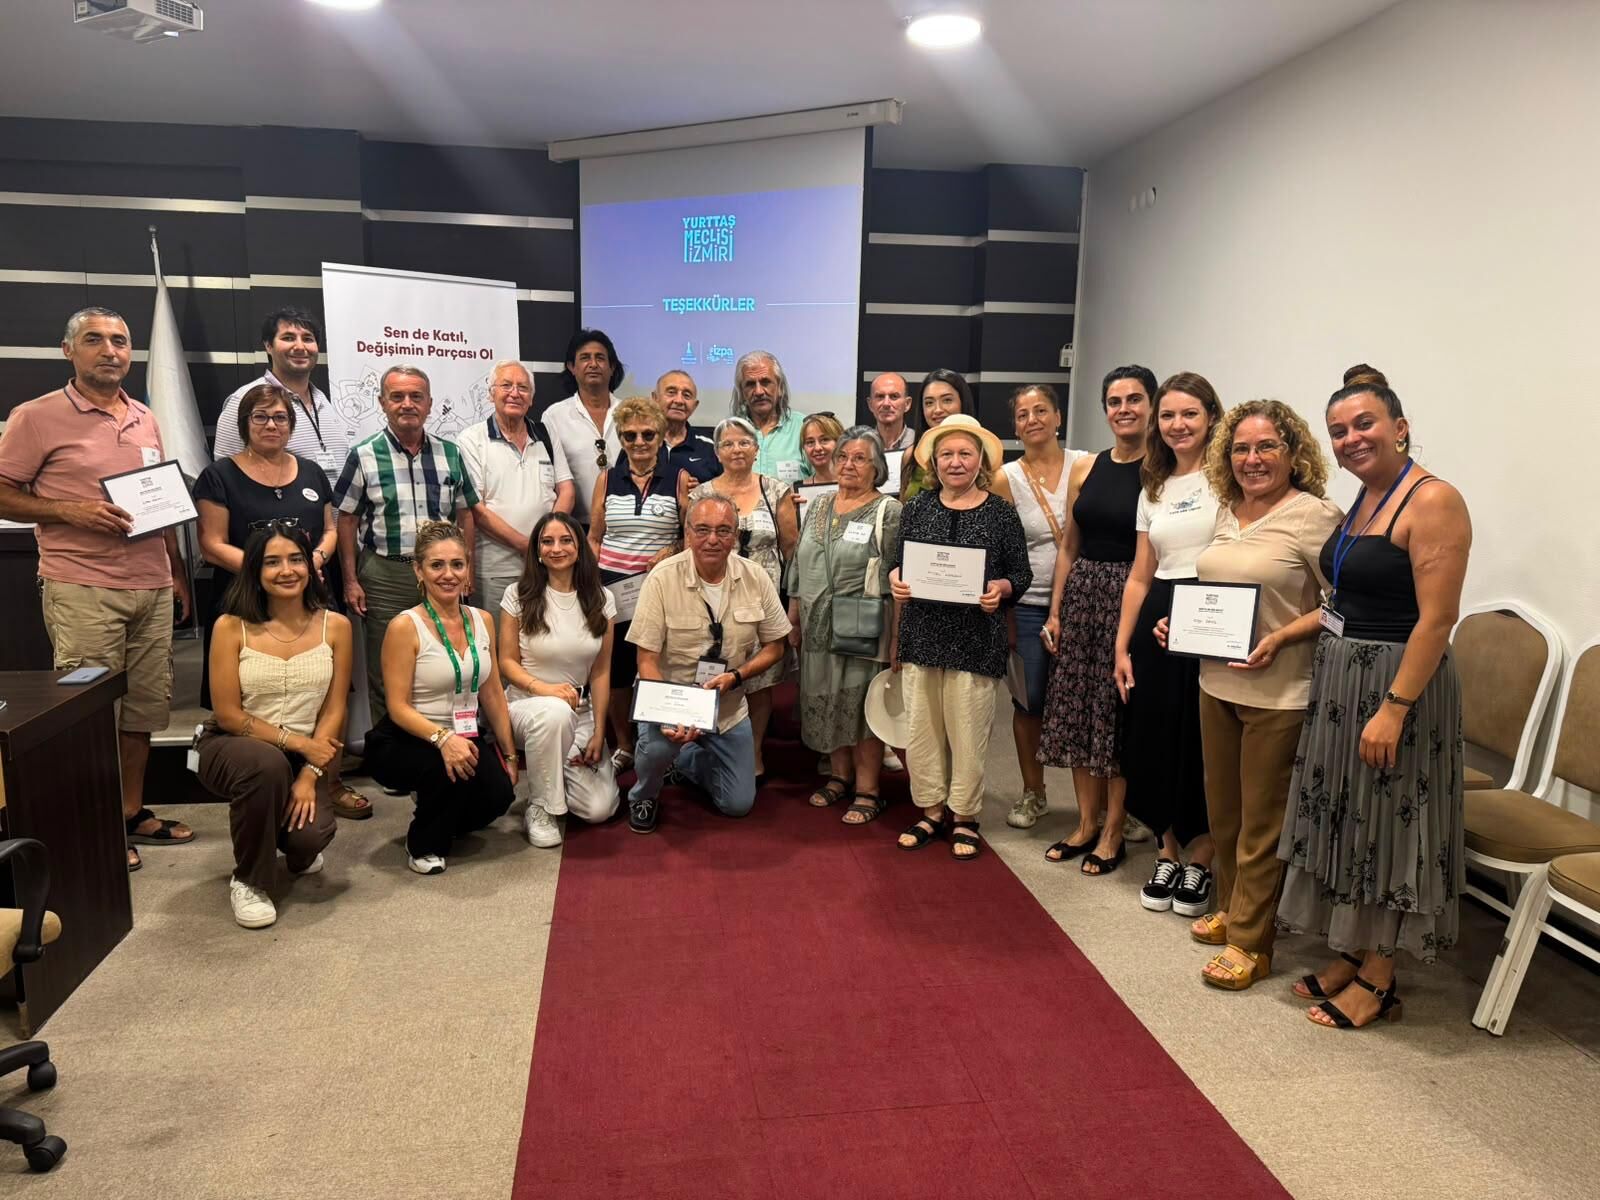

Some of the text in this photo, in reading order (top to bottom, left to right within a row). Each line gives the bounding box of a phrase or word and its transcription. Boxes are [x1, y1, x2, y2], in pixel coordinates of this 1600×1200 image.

[682, 215, 736, 228] YURTTAŞ
[662, 295, 756, 314] TEŞEKKÜRLER
[384, 326, 467, 344] Sen de Katıl,
[357, 340, 493, 360] Değişimin Parçası Ol
[713, 344, 733, 358] izpa
